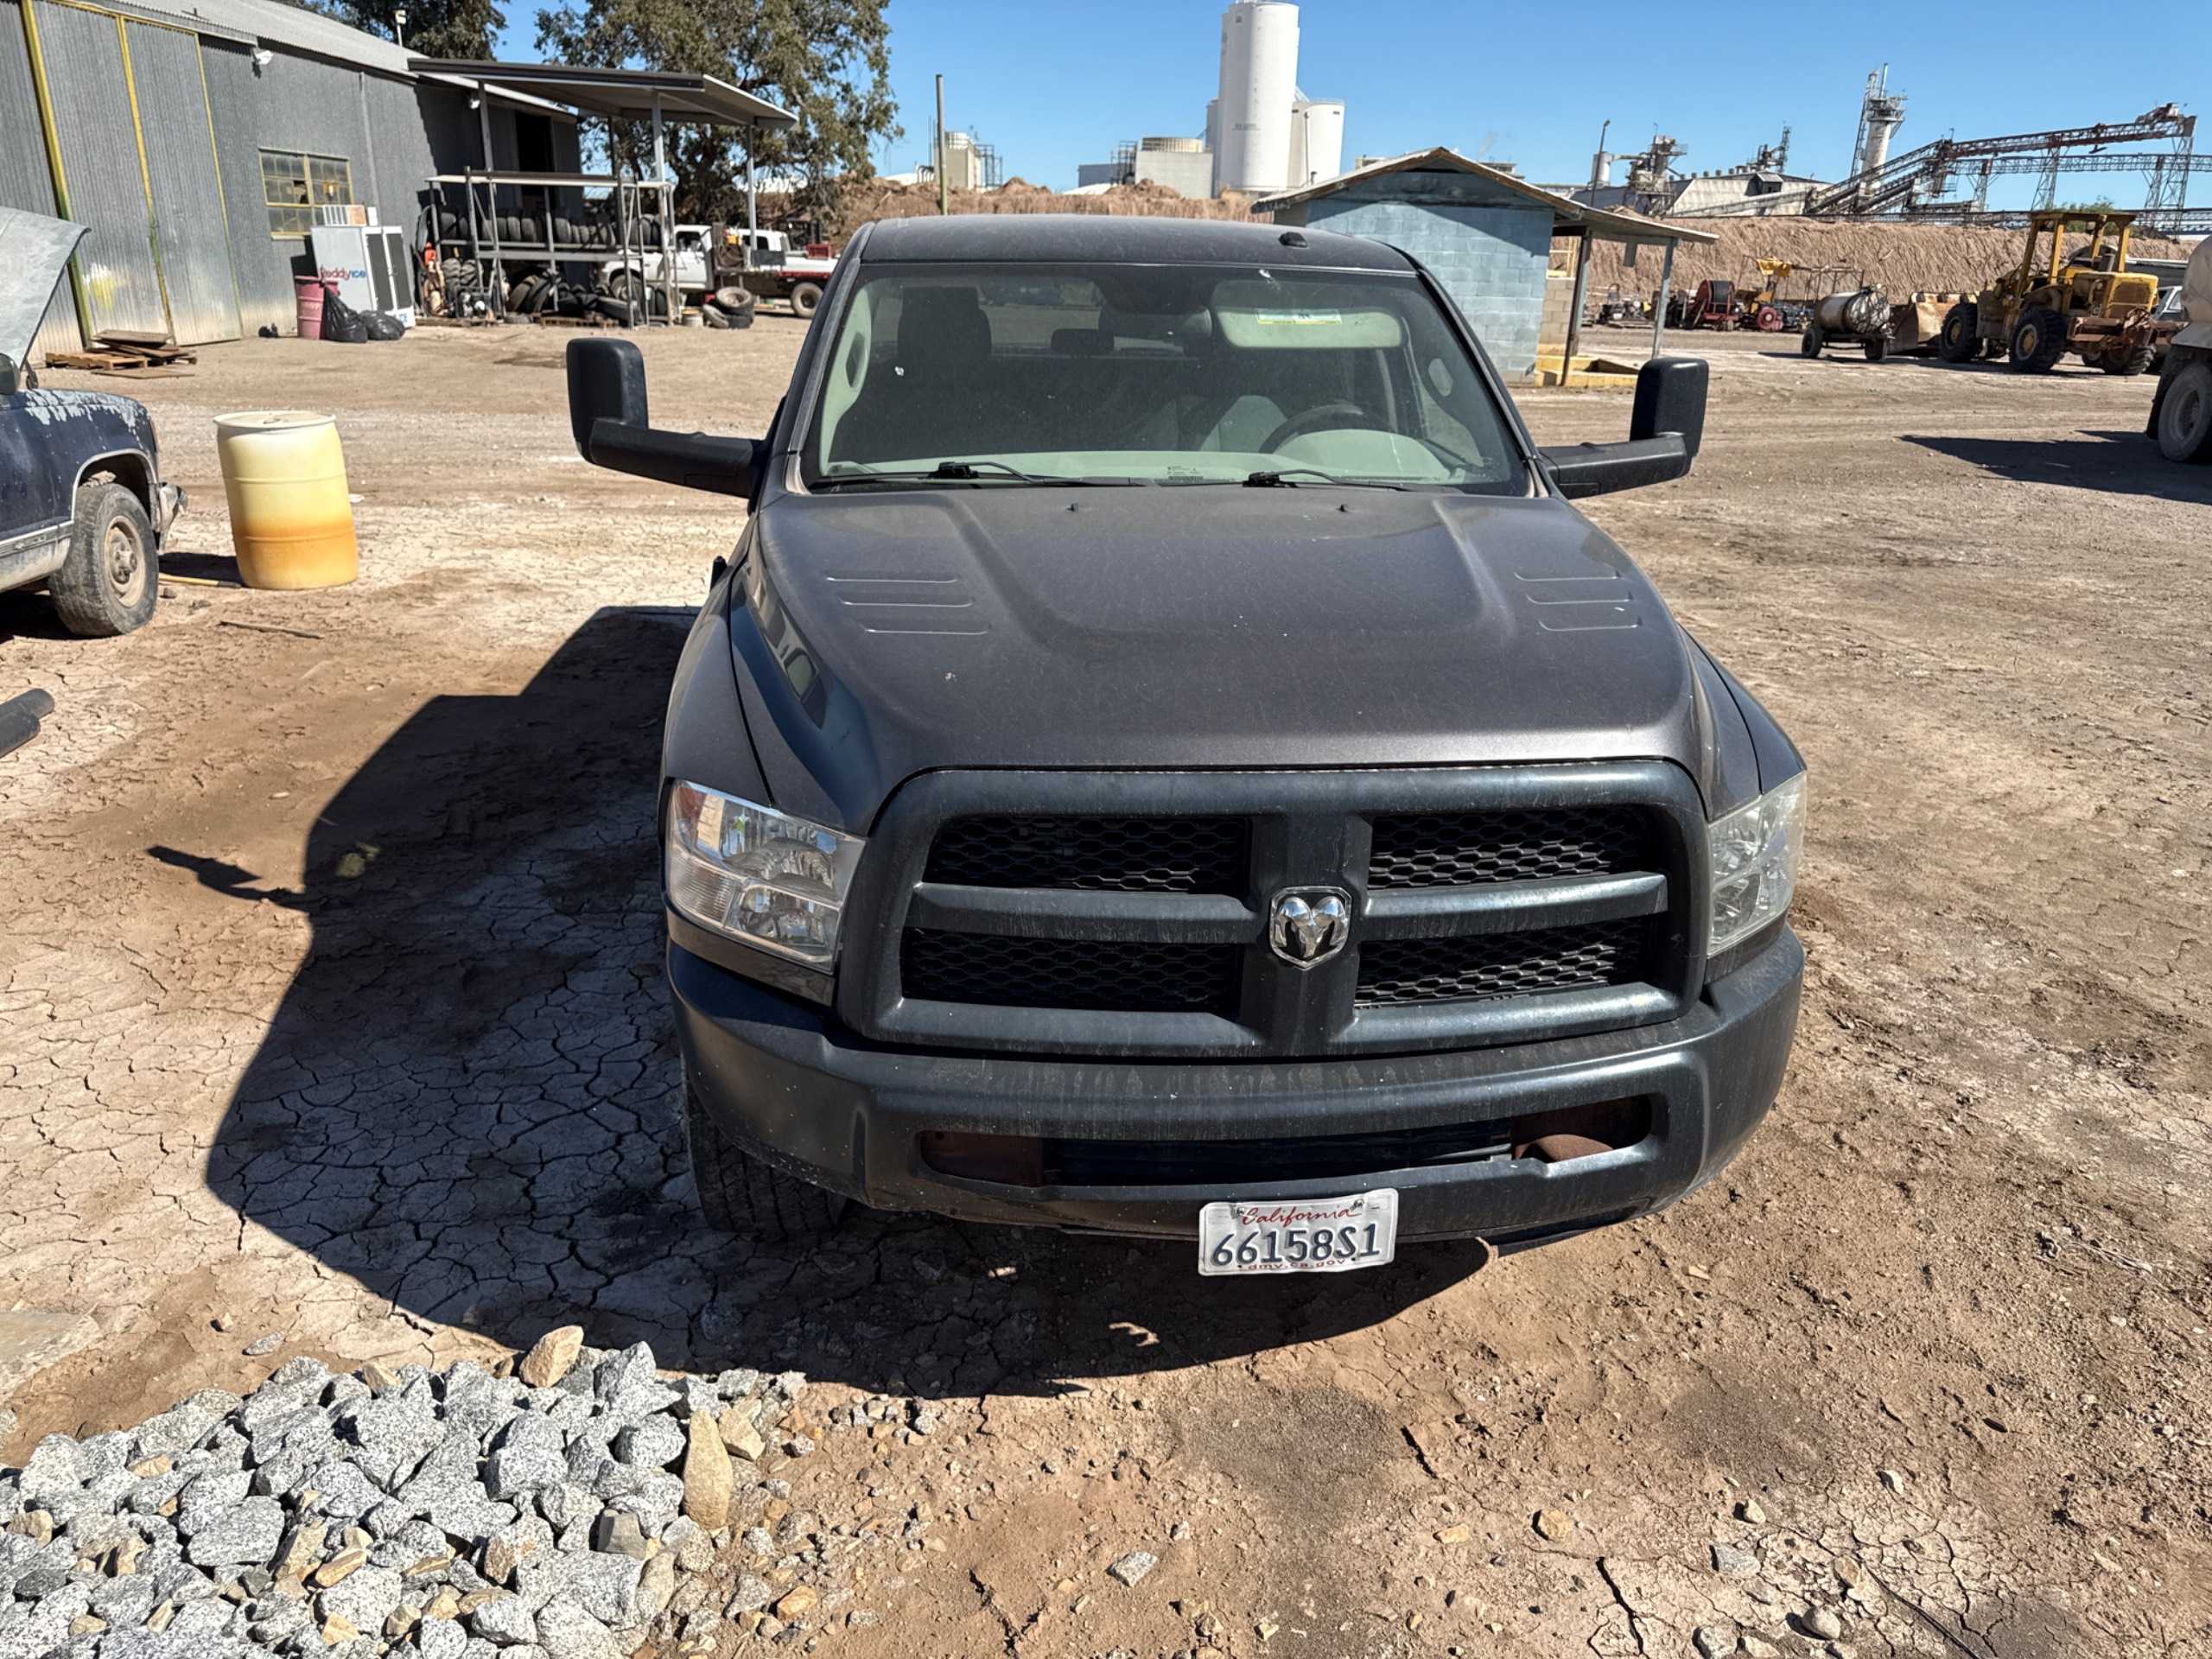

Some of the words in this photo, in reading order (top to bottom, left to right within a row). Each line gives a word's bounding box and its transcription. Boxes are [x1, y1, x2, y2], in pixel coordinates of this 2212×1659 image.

[1242, 1206, 1363, 1228] California
[1211, 1223, 1380, 1267] 66158S1
[1247, 1258, 1346, 1271] dmv.ca.gov
